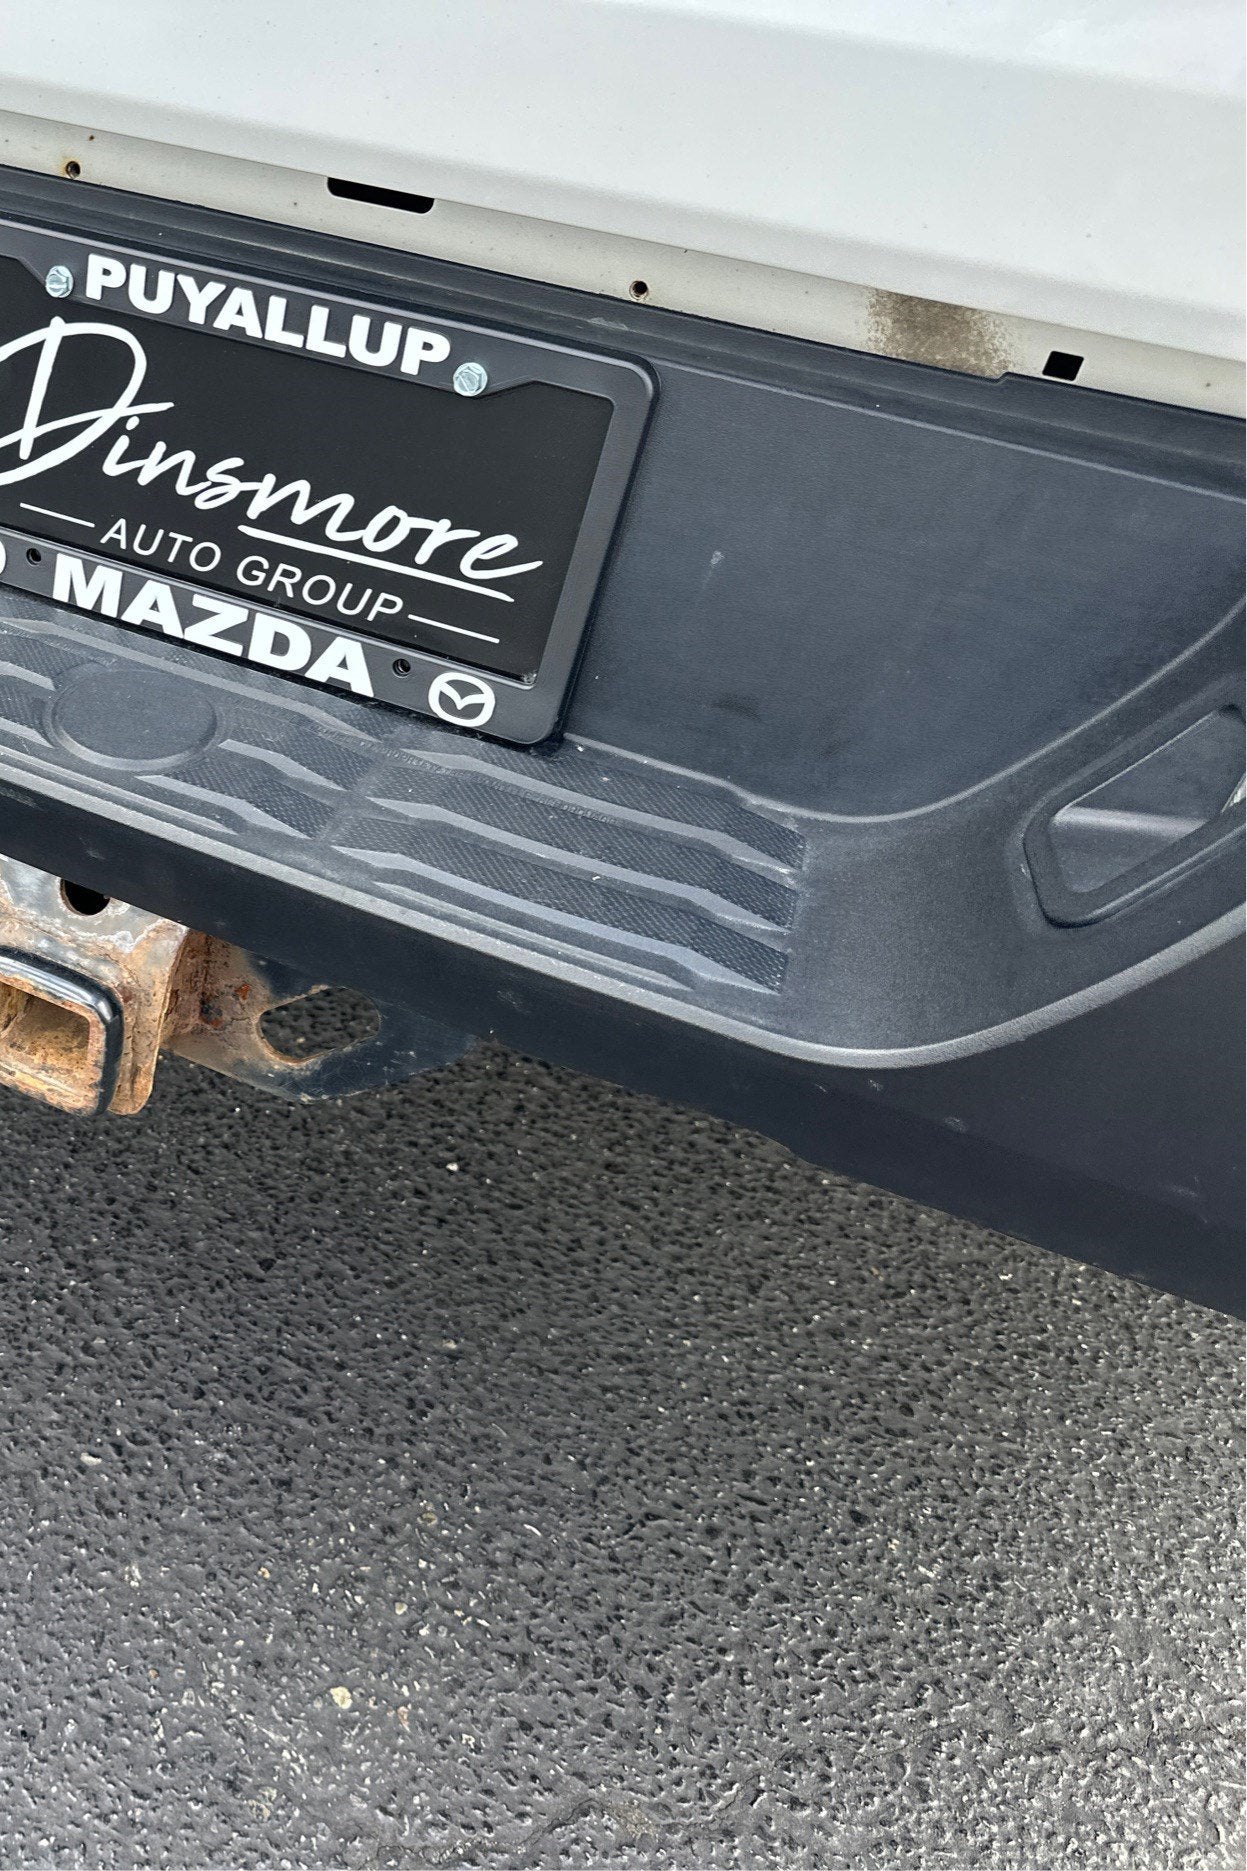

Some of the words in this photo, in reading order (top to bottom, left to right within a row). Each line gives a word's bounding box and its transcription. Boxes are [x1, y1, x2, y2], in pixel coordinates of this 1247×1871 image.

[85, 253, 451, 376] PUYALLUP
[51, 552, 376, 699] MAZDA
[99, 517, 222, 572] AUTO
[236, 555, 404, 623] GROUP
